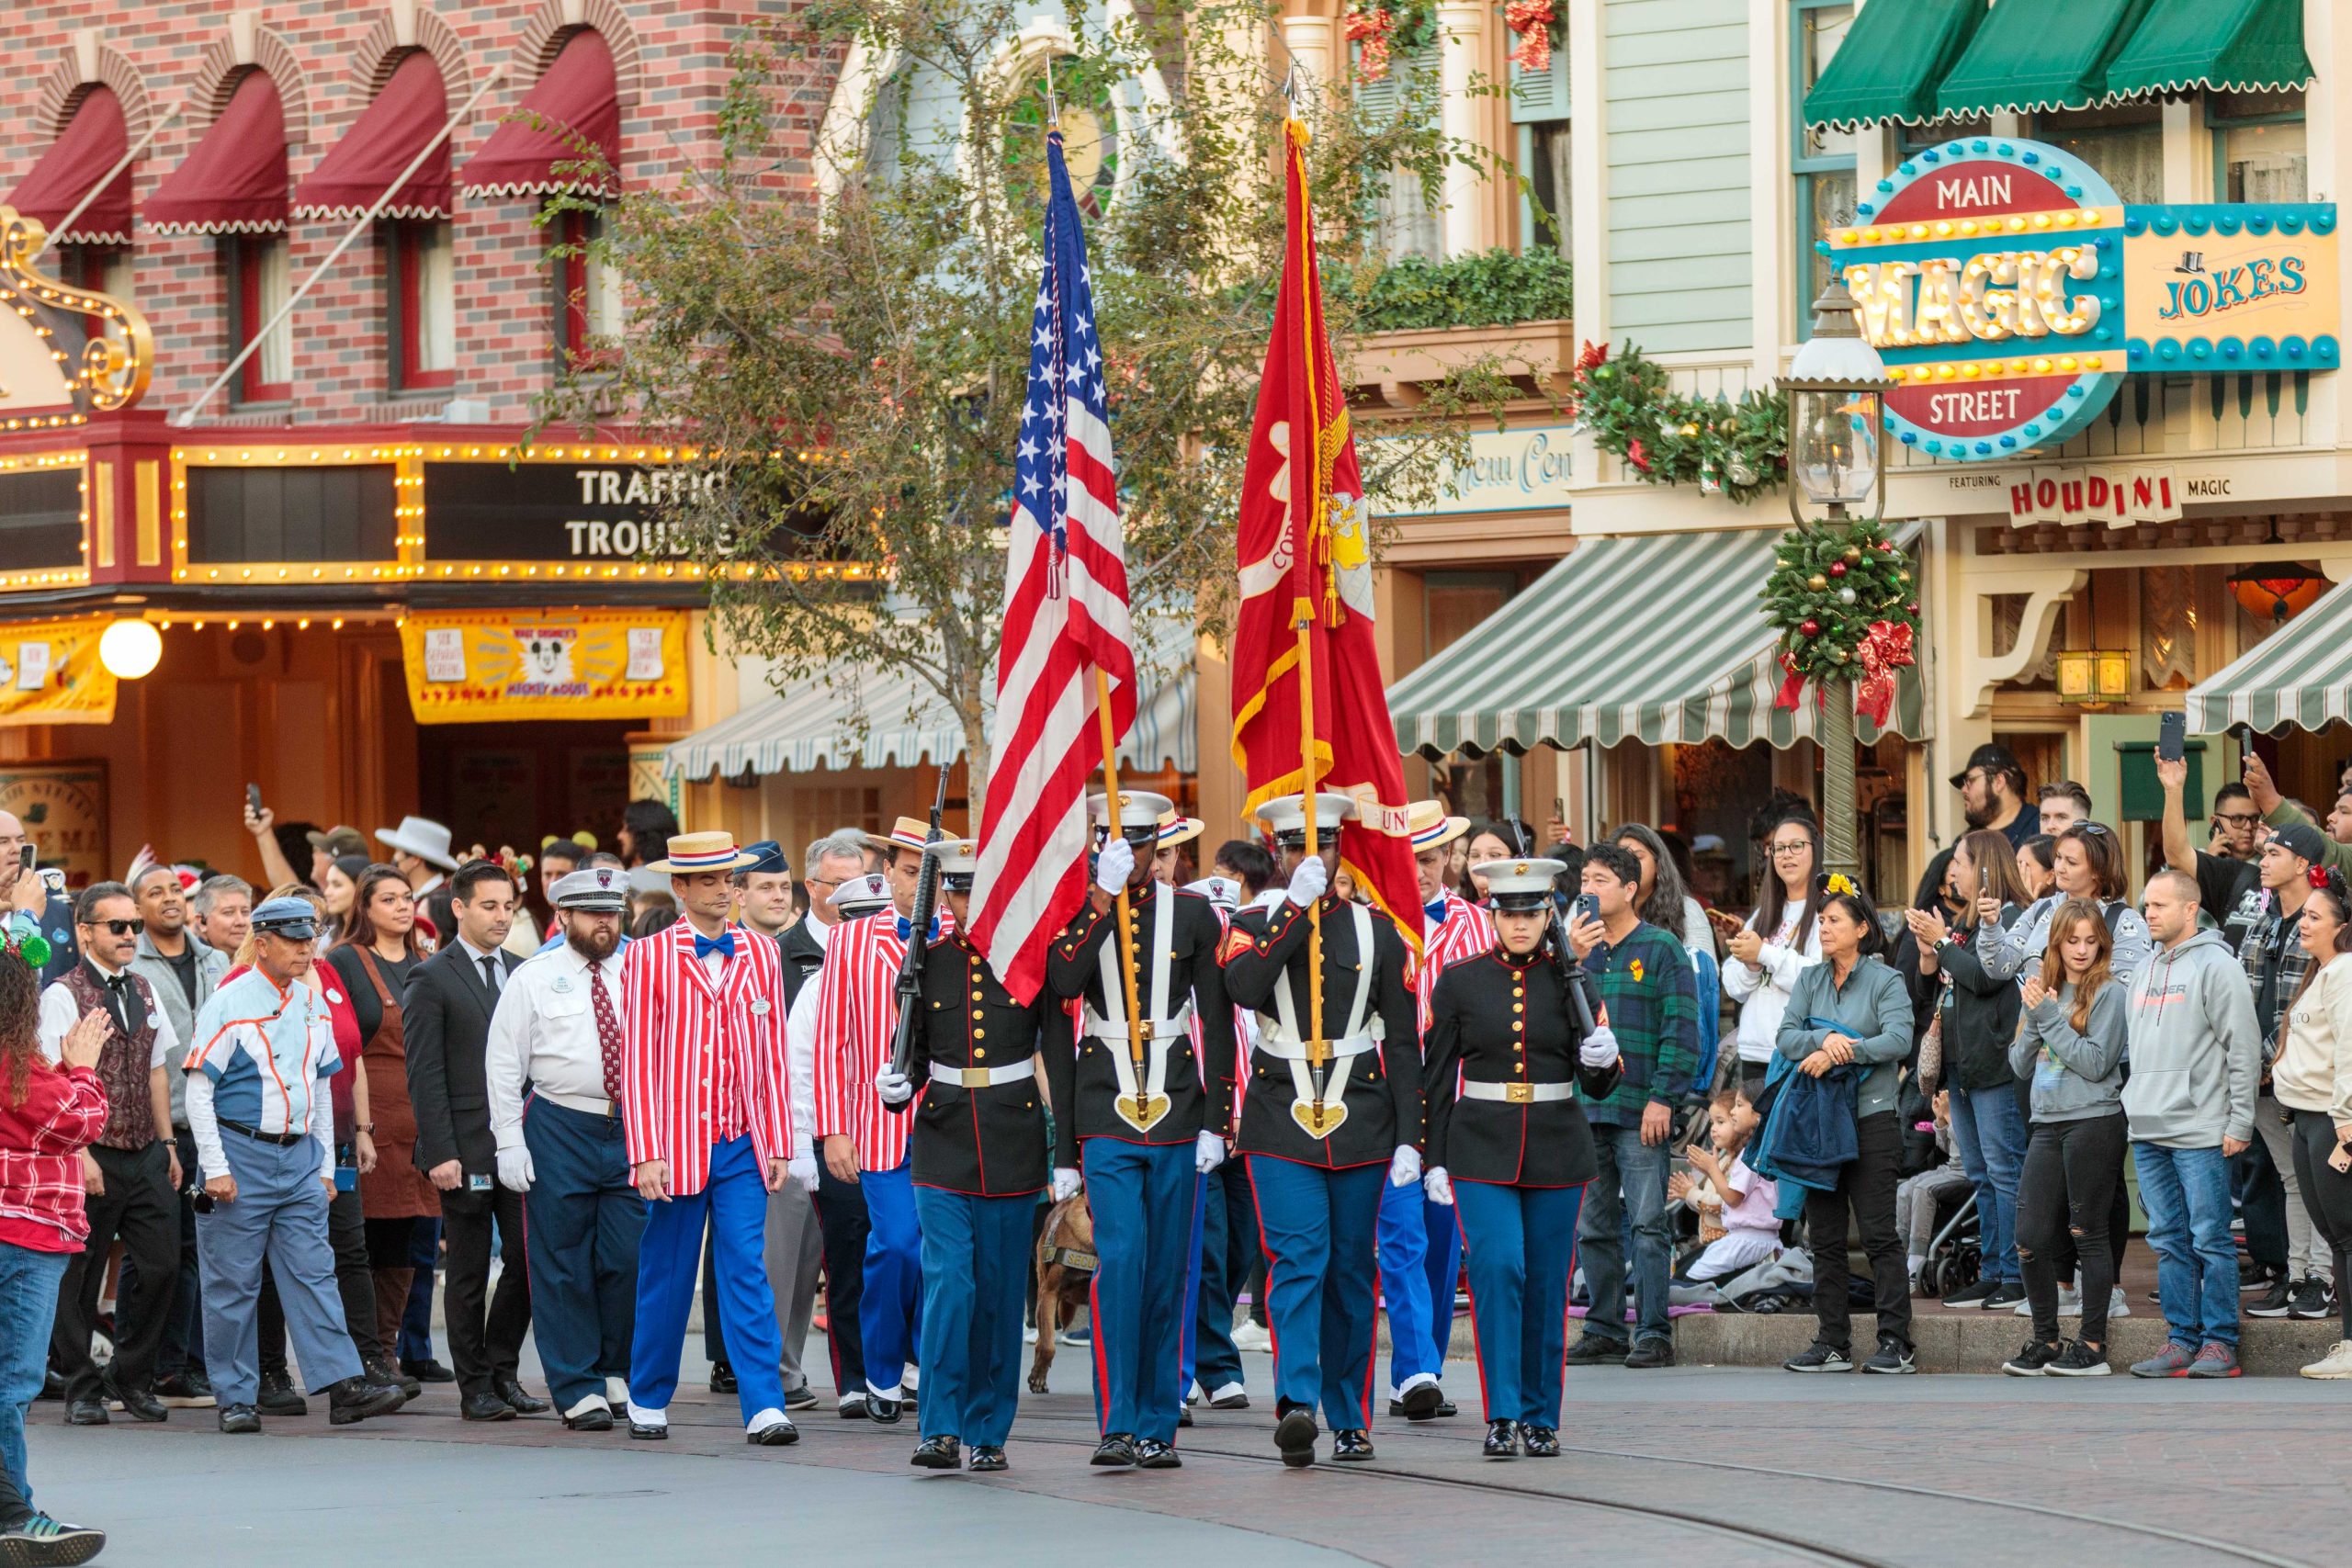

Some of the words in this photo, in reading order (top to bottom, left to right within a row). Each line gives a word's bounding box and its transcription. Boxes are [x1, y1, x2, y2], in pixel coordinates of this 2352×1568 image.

[1937, 175, 2012, 209] MAIN
[1844, 243, 2101, 347] MAGIC
[2158, 255, 2307, 321] JOKES
[1929, 389, 2021, 424] STREET
[1949, 475, 2002, 489] FEATURING
[2010, 476, 2173, 516] HOUDINI
[2188, 479, 2232, 497] MAGIC
[564, 521, 735, 556] TROUBE
